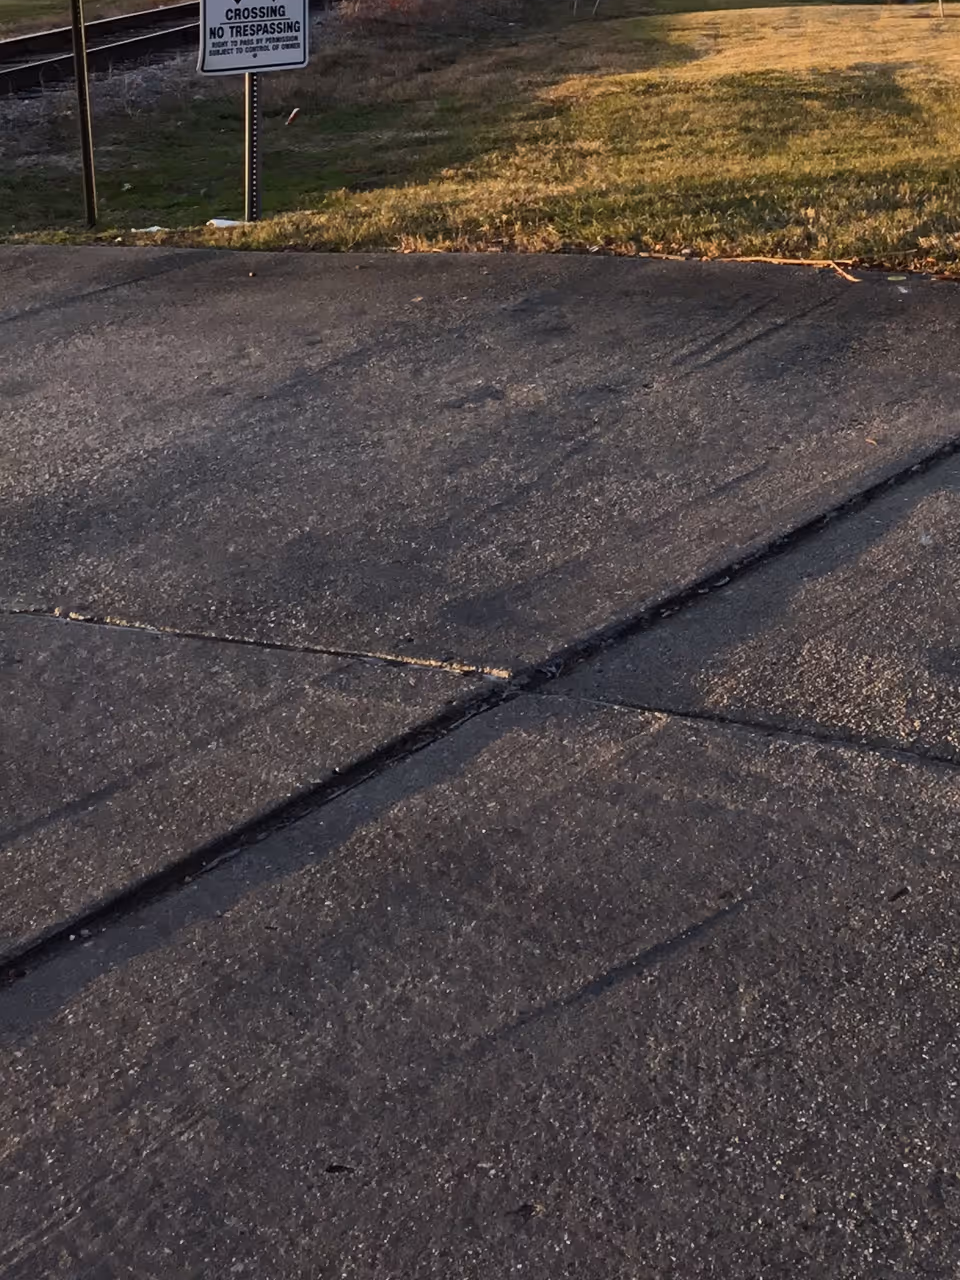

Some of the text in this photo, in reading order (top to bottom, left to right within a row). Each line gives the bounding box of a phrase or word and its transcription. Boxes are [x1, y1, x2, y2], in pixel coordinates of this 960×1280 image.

[225, 5, 286, 20] CROSSING
[209, 21, 300, 39] NO TRESPASSING
[271, 43, 280, 51] OF
